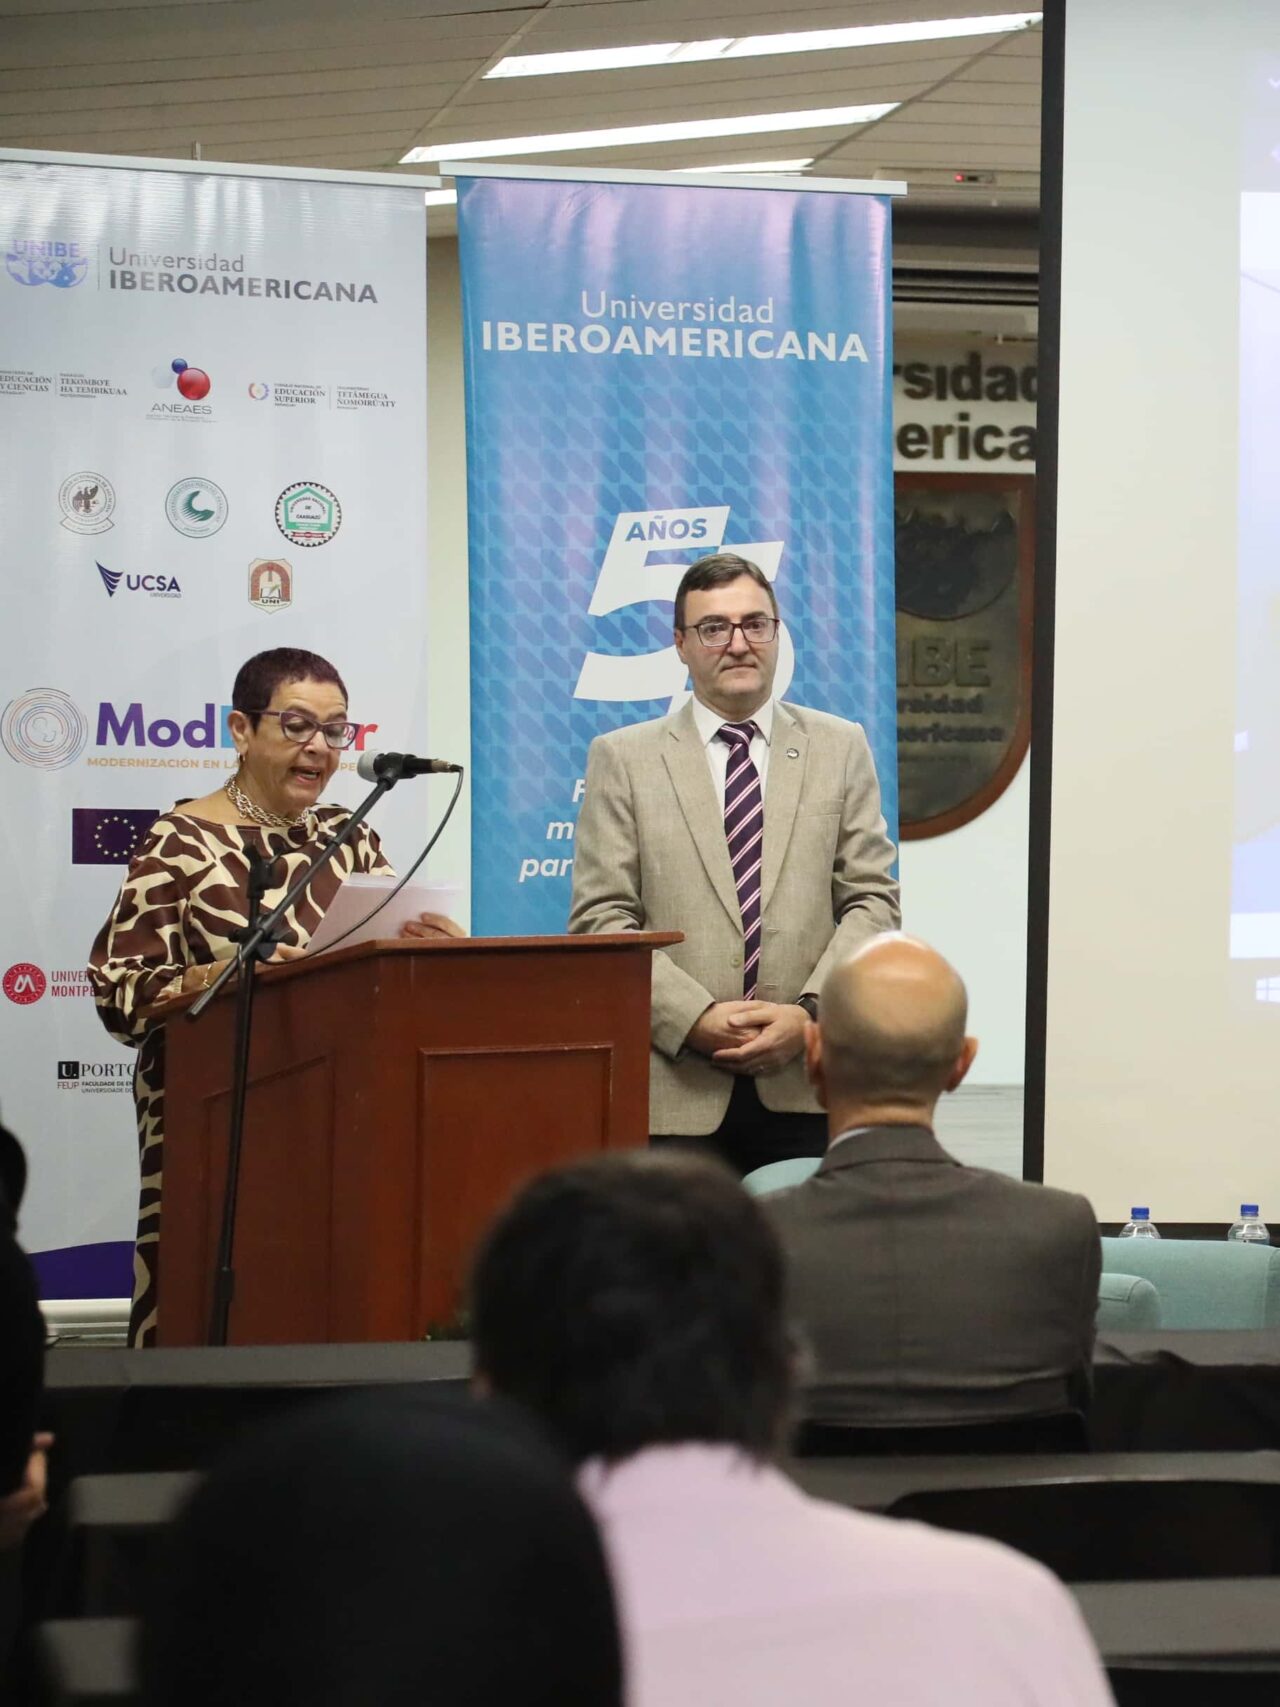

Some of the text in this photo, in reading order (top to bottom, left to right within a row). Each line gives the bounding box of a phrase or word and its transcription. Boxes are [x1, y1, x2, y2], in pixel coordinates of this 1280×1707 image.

[12, 240, 81, 258] UNIBE
[108, 246, 245, 273] Universidad
[108, 269, 379, 304] IBEROAMERICANA
[581, 290, 774, 324] Universidad
[481, 321, 870, 363] IBEROAMERICANA
[151, 402, 213, 415] ANEAES
[624, 514, 709, 543] AÑOS
[126, 574, 182, 593] UCSA
[203, 760, 220, 769] EN
[57, 1081, 80, 1090] FEUP
